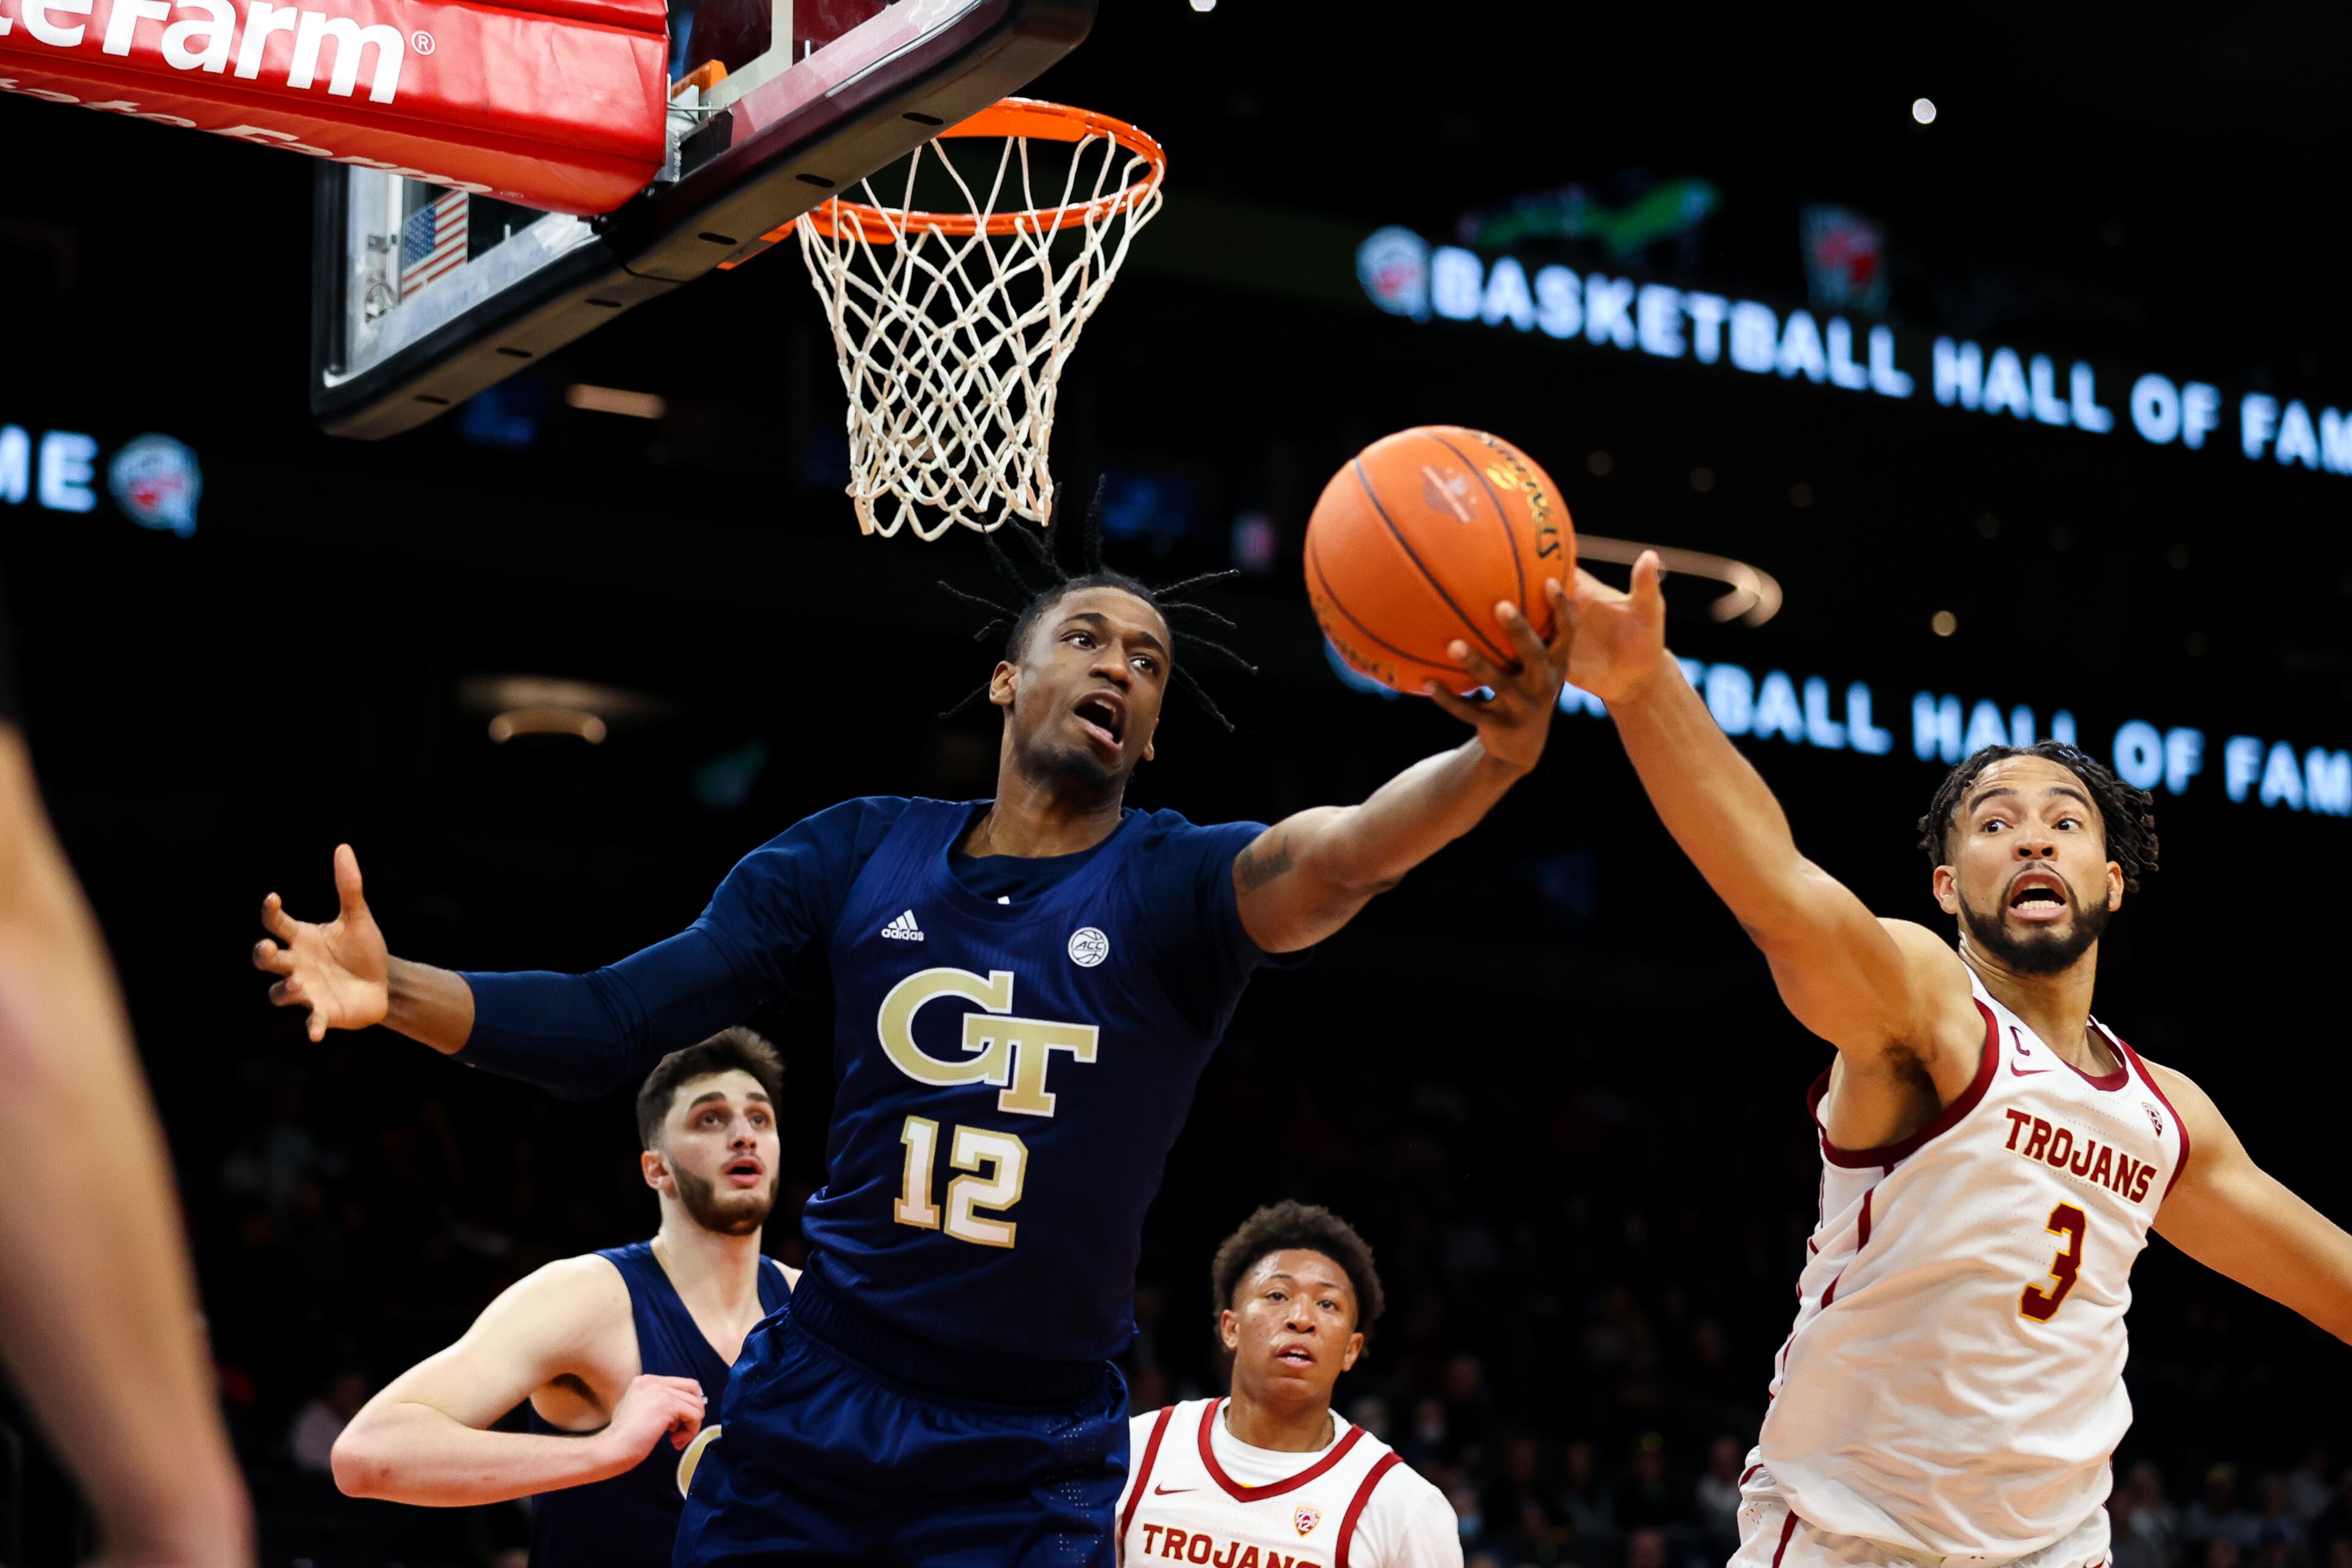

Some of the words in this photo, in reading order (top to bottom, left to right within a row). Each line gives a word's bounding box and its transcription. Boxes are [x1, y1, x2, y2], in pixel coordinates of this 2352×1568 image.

[1430, 244, 1915, 398] BASKETBALL
[1932, 336, 2114, 434] HALL
[2129, 373, 2222, 451] OF
[2112, 719, 2204, 794] OF
[881, 927, 924, 941] adidas
[1074, 941, 1105, 951] ACC
[877, 967, 1100, 1118] GT
[894, 1114, 1030, 1249] 12
[2005, 1107, 2157, 1205] TROJANS
[2018, 1201, 2087, 1324] 3
[1142, 1522, 1323, 1568] TROJA
